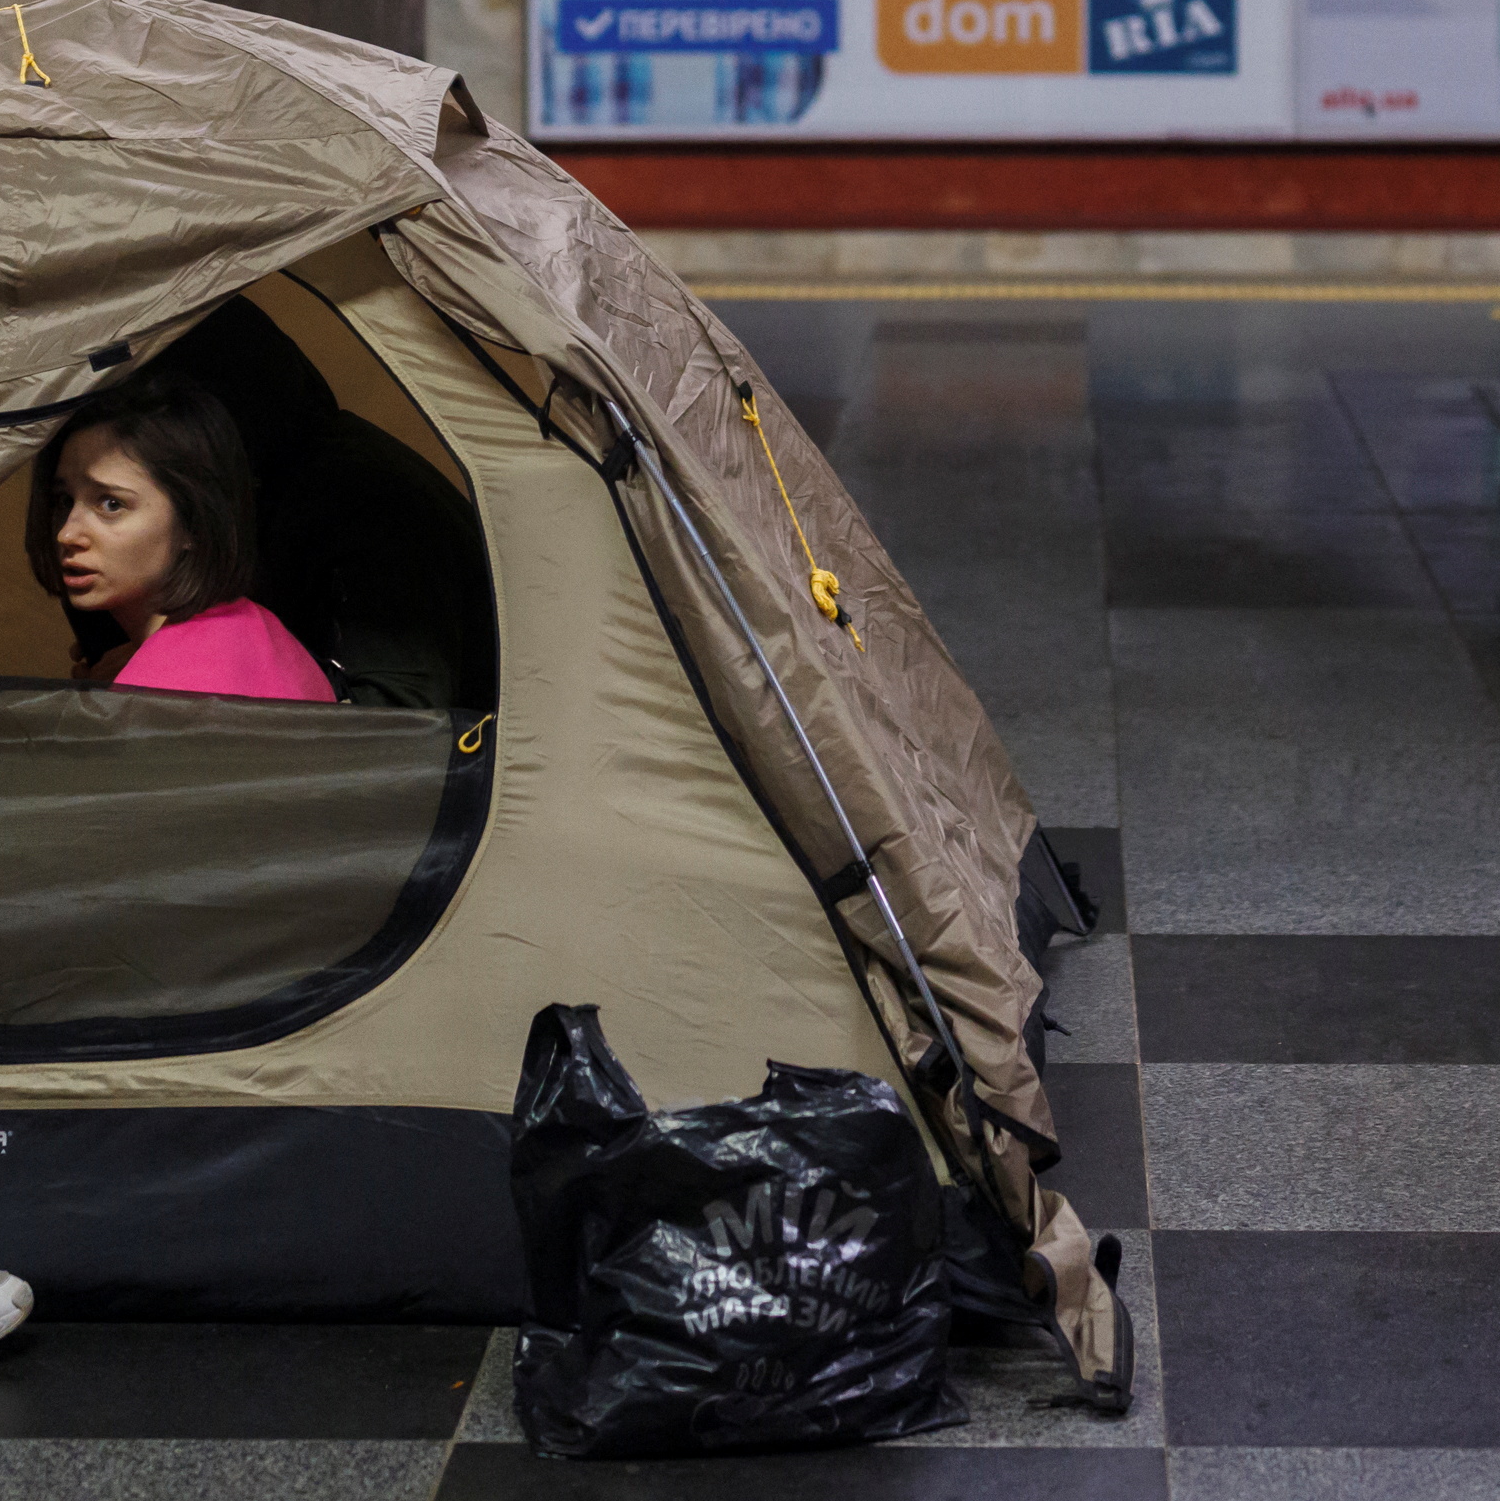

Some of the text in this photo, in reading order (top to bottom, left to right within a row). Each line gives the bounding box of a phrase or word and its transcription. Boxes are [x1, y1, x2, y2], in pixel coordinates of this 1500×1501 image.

[618, 8, 823, 42] ПЕРЕВІРЕНО
[703, 1180, 880, 1259] МІЙ
[684, 1293, 854, 1338] МАГАЗИ
